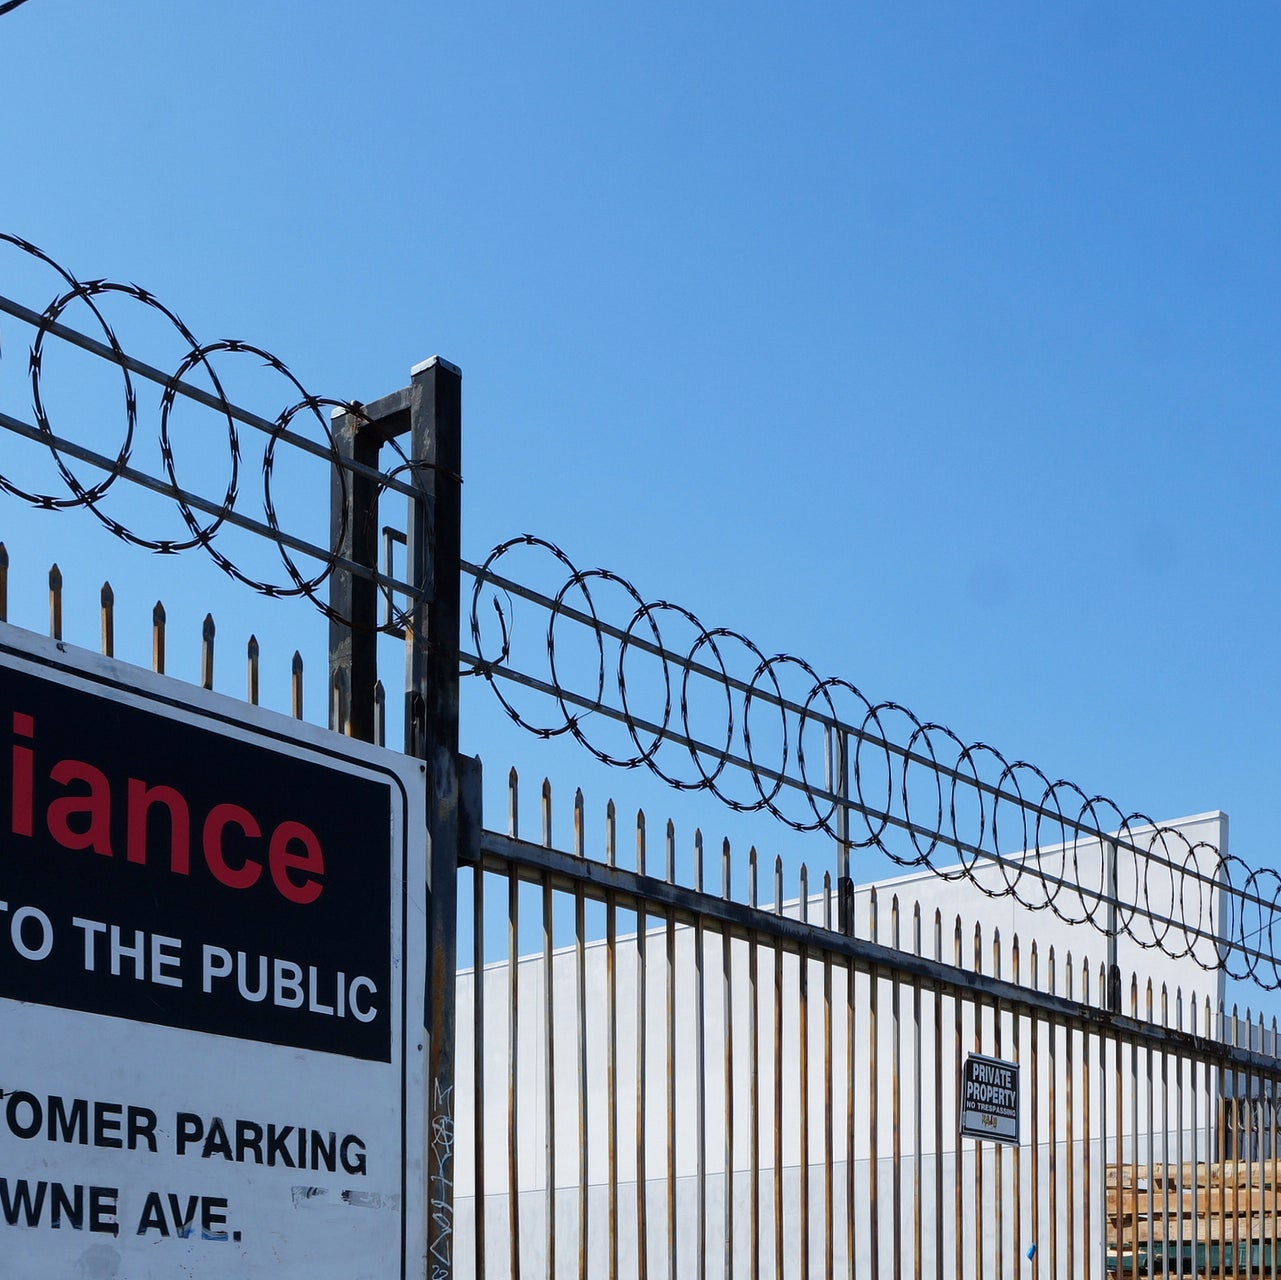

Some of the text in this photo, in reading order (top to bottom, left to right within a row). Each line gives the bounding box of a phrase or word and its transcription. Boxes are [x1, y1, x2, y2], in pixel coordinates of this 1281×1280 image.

[72, 916, 183, 988] THE
[203, 944, 378, 1023] PUBLIC
[967, 1081, 1016, 1107] PROPERTY
[973, 1064, 1011, 1087] PRIVATE
[967, 1101, 1016, 1116] NO TRESPASSING
[175, 1111, 367, 1176] PARKING
[135, 1190, 242, 1242] AVE.
